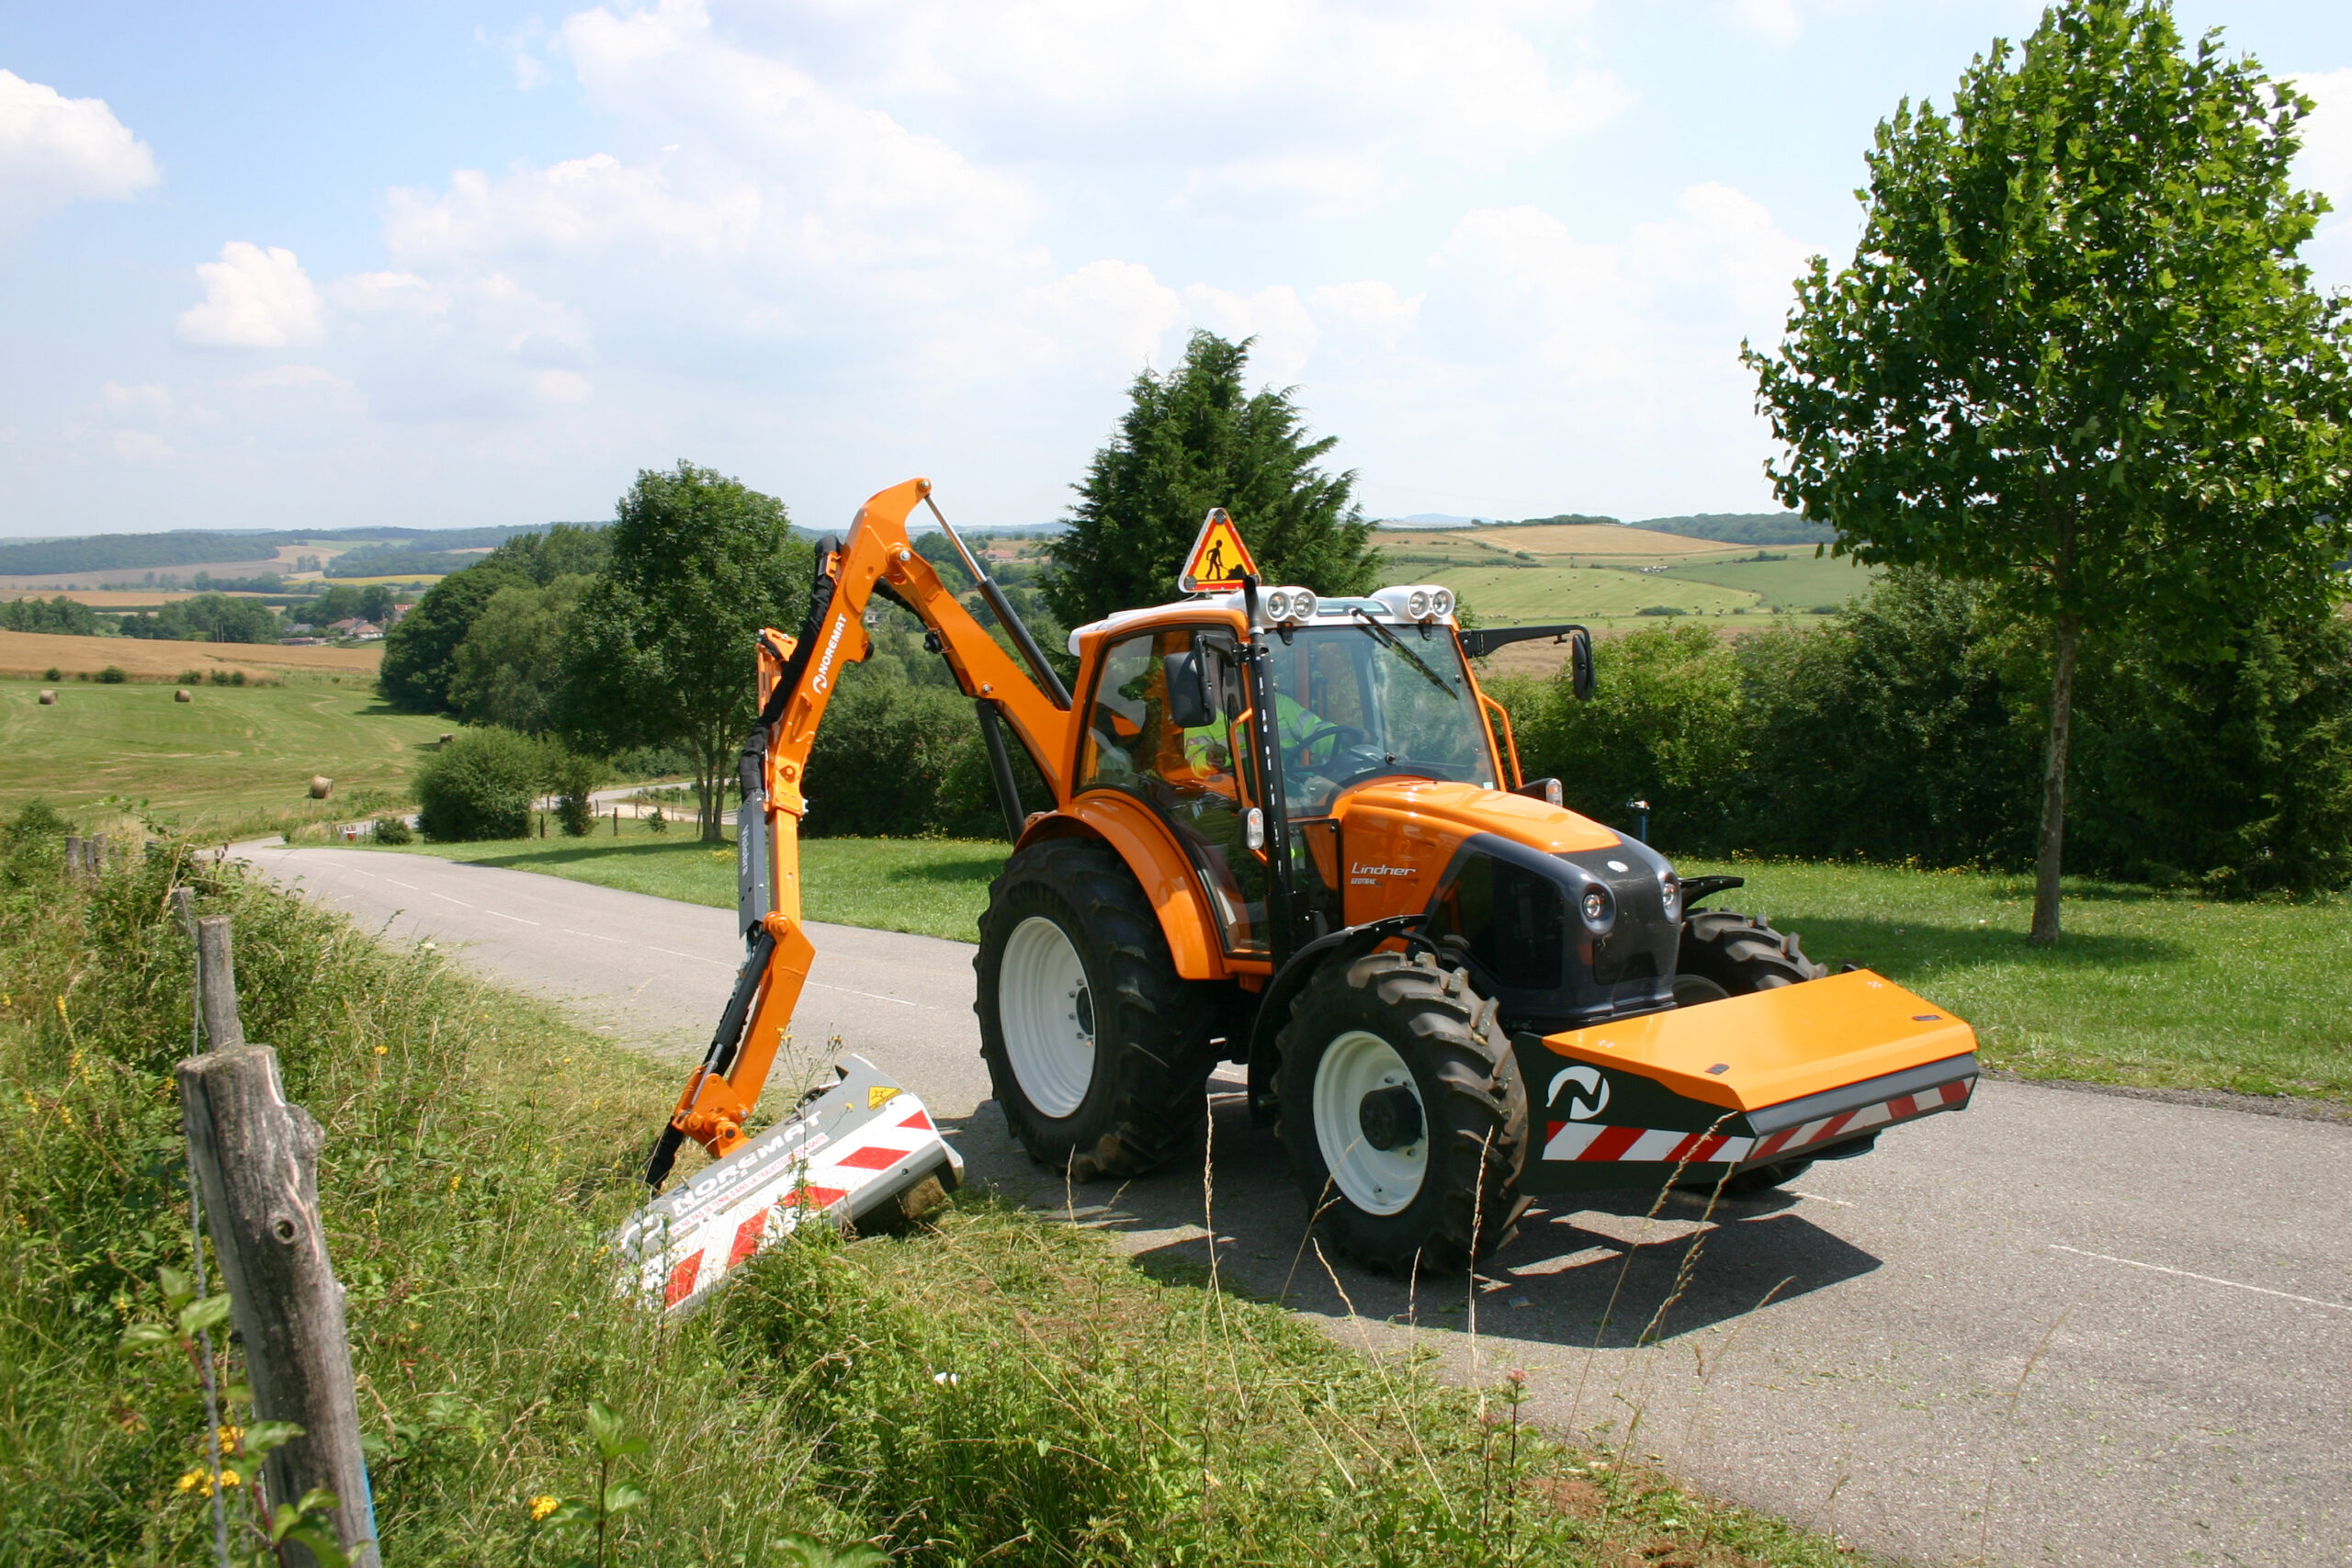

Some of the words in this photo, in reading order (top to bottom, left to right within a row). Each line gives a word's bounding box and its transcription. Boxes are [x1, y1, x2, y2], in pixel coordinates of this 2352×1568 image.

[818, 613, 847, 674] NOREMAT
[1351, 862, 1417, 875] Lindner
[672, 1110, 823, 1213] NOREMAT
[729, 1181, 749, 1197] DANS
[748, 1176, 757, 1185] LA
